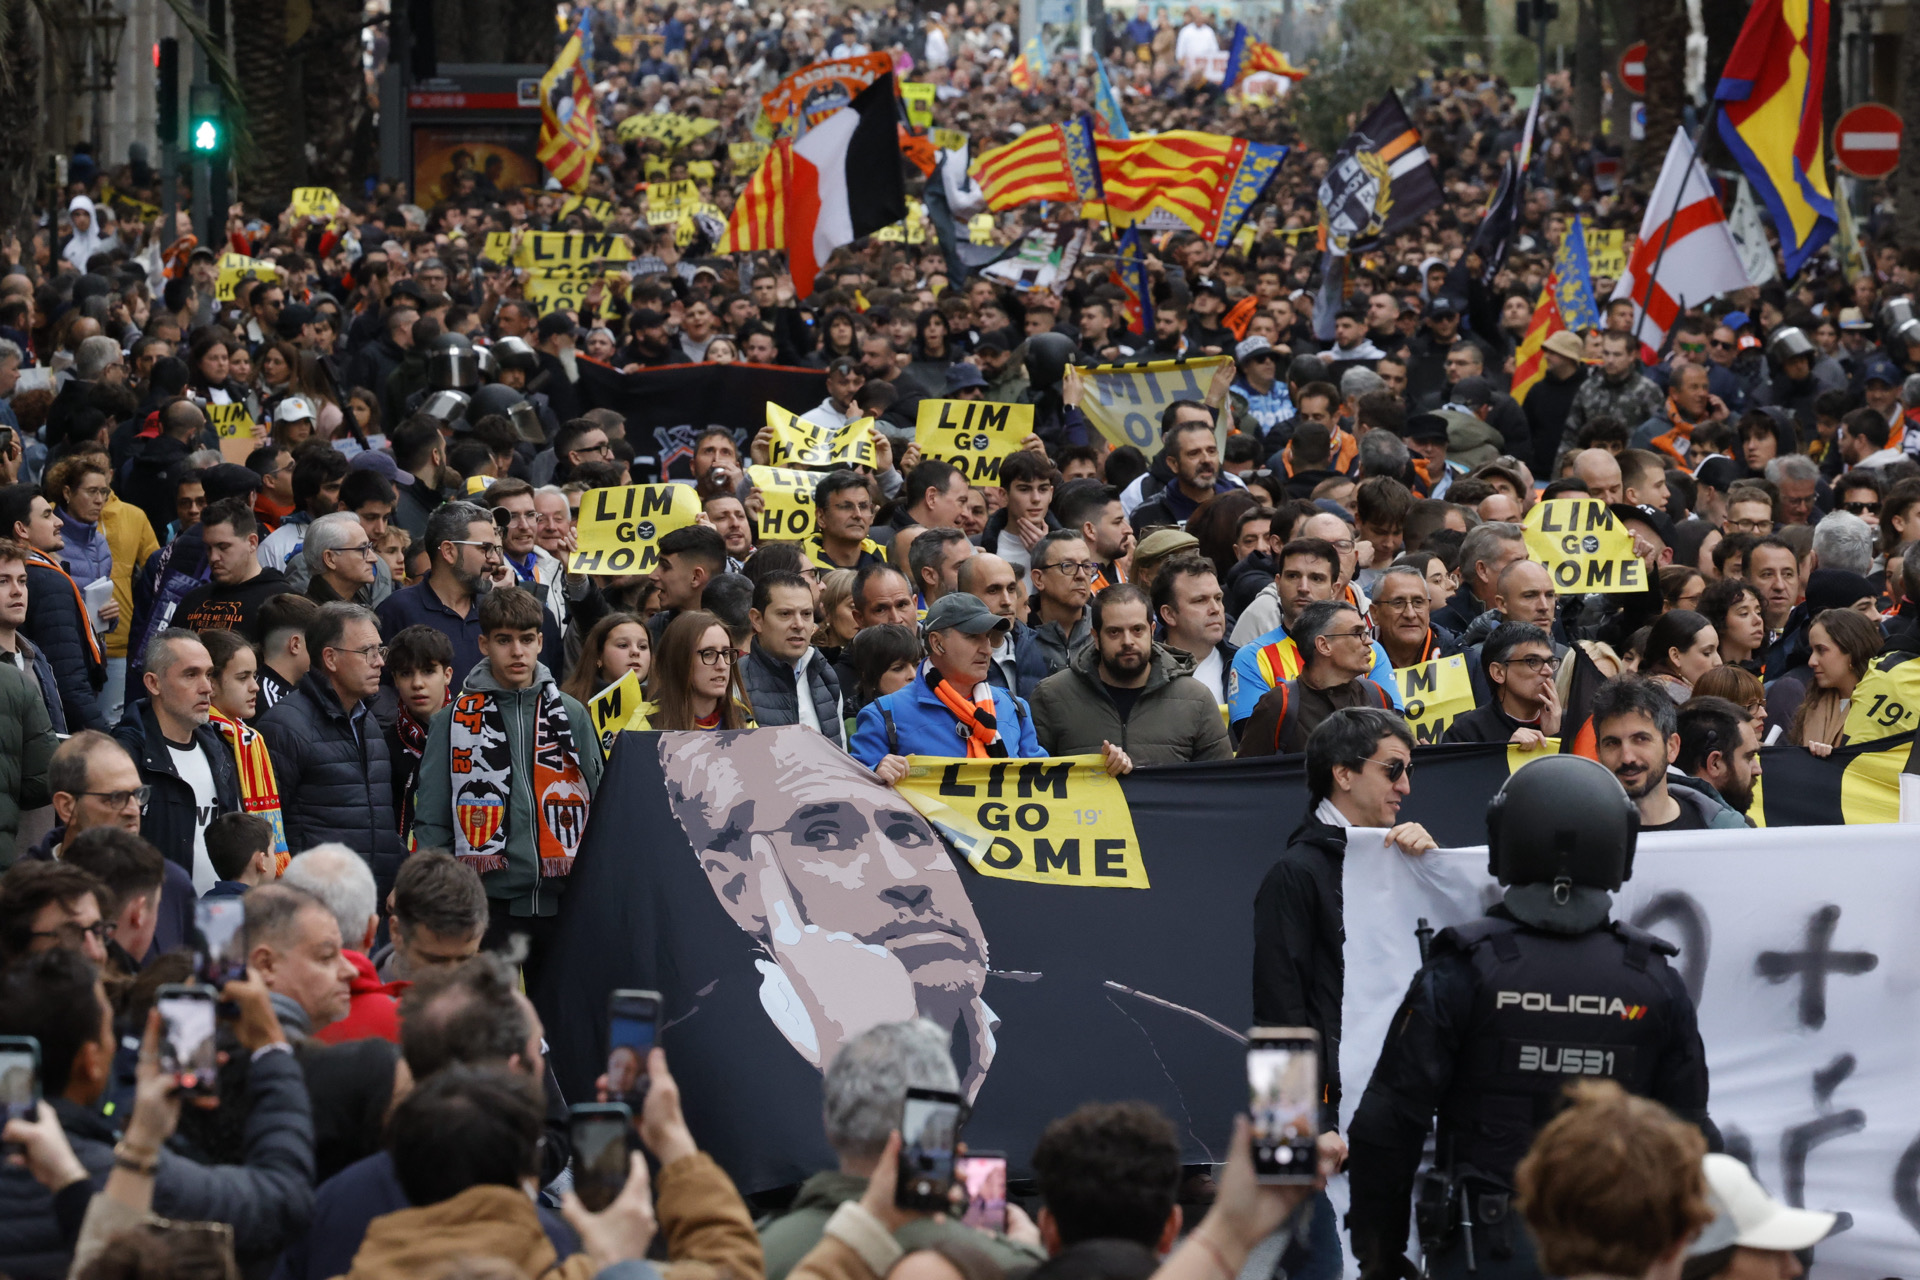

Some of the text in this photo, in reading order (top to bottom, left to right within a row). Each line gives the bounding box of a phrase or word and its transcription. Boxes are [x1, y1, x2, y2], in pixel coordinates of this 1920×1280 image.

[302, 190, 333, 202] LIM
[657, 182, 688, 198] LIM
[534, 235, 613, 261] LIM
[214, 403, 245, 422] LIM
[938, 402, 1011, 432] LIM
[789, 415, 852, 443] LIM
[773, 441, 872, 465] HOME
[595, 486, 675, 522] LIM
[1541, 501, 1614, 532] LIM
[762, 509, 818, 534] HO
[1541, 559, 1639, 587] OME
[939, 762, 1076, 799] LIM
[977, 802, 1050, 832] GO
[1496, 991, 1628, 1016] POLICIA
